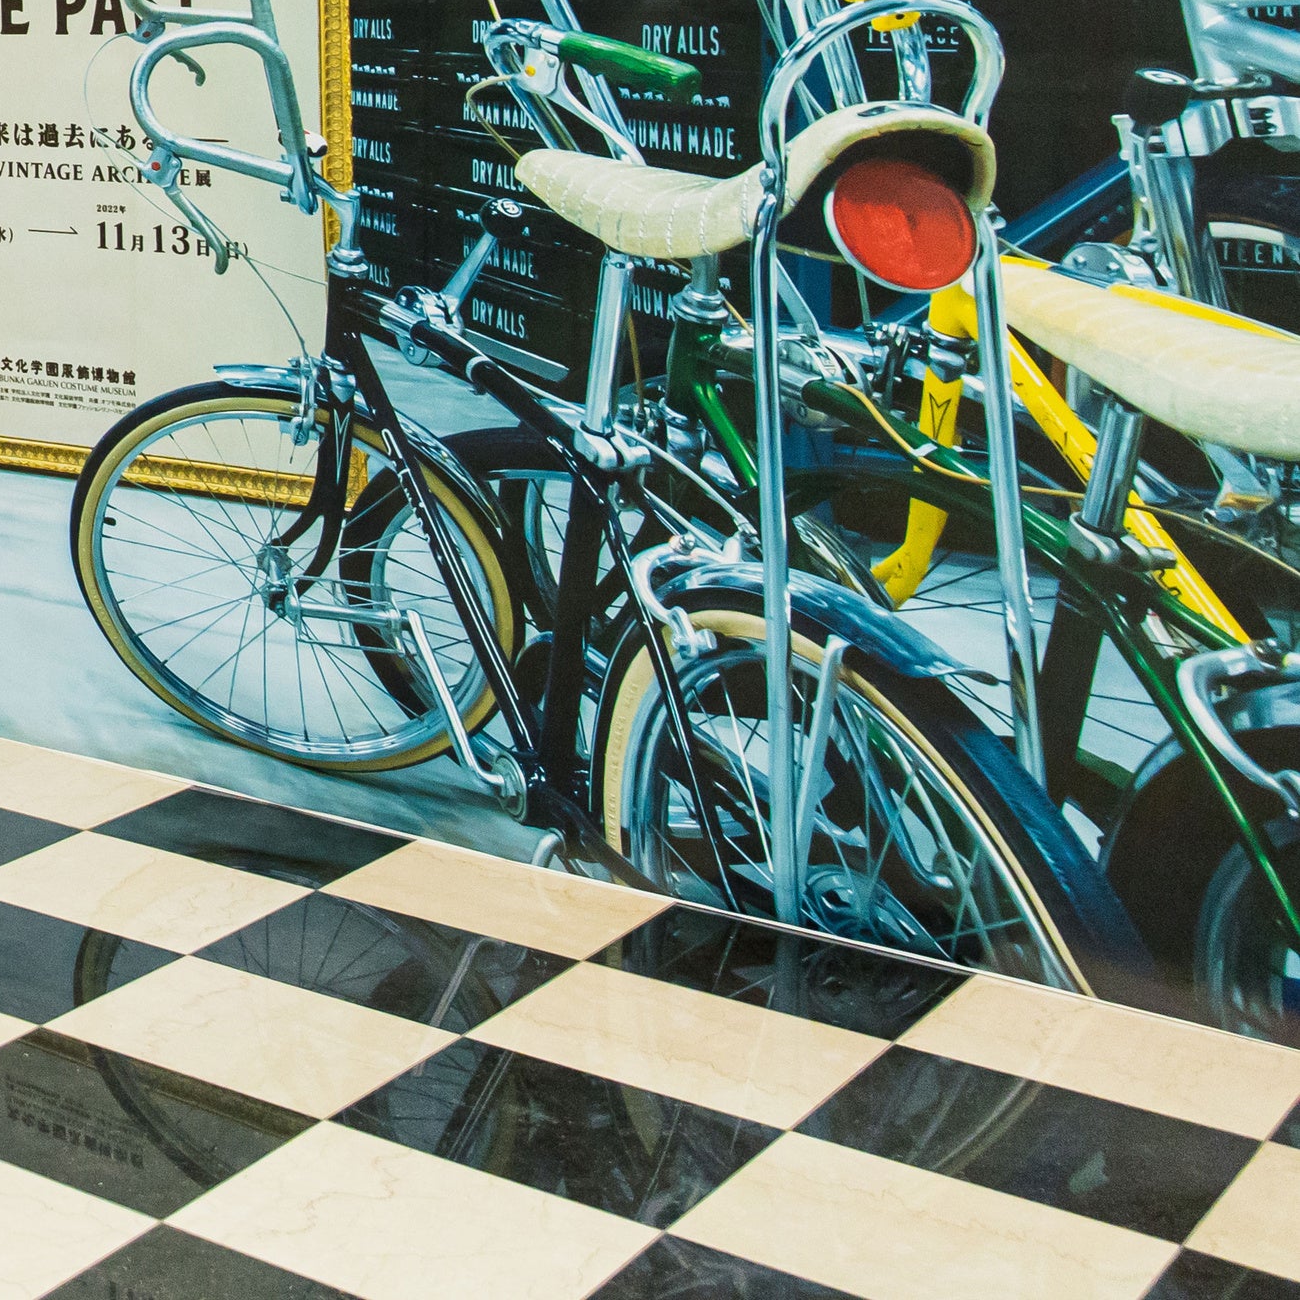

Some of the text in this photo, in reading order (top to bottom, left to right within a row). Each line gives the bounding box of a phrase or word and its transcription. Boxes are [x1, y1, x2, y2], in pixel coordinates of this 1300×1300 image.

[354, 18, 392, 40] DRY ALLS
[472, 20, 489, 43] DR
[642, 24, 719, 56] DRY ALLS
[352, 89, 399, 111] UMAN MADE
[353, 137, 391, 164] DRY ALLS
[628, 119, 736, 160] HUMAN MADE
[472, 158, 493, 184] DRY
[96, 204, 126, 214] 2022年
[374, 212, 398, 236] MADE
[97, 221, 248, 260] 11月13日日)
[464, 236, 534, 278] HAN MADE
[369, 264, 390, 287] ALLS
[632, 284, 675, 321] HUMA
[472, 298, 526, 339] DRY ALLS
[0, 357, 136, 386] 文化学園服飾博物館
[26, 378, 59, 389] GAKUEN
[60, 382, 98, 393] COSTUME
[100, 386, 136, 397] MUSEUM
